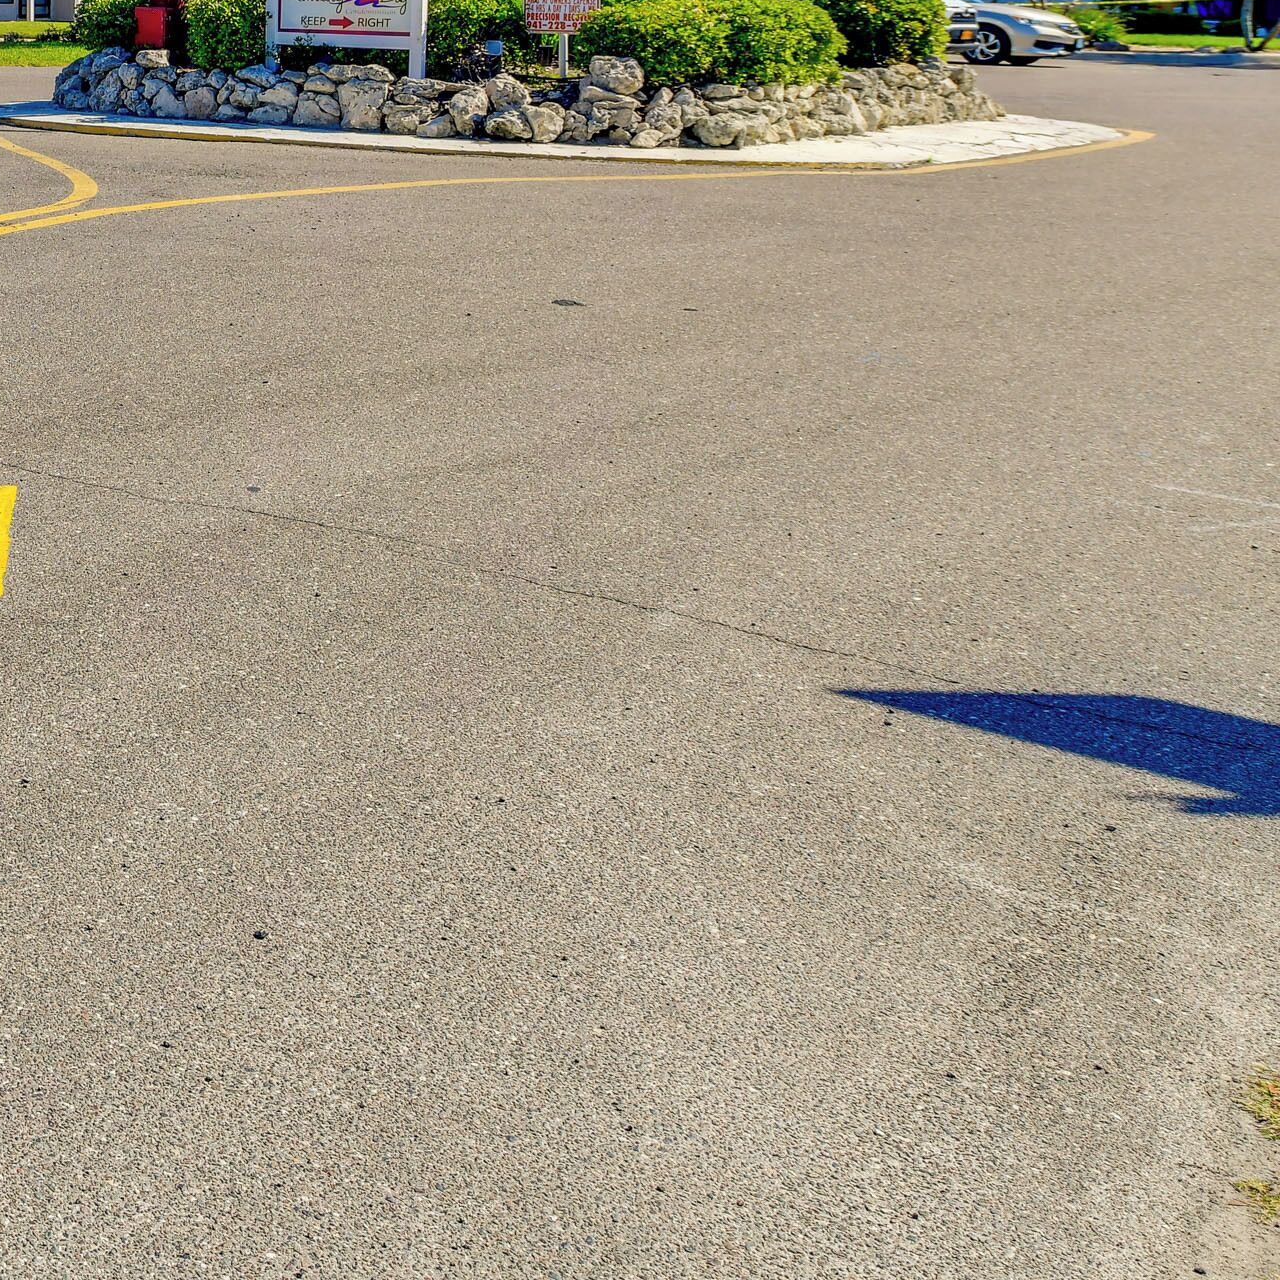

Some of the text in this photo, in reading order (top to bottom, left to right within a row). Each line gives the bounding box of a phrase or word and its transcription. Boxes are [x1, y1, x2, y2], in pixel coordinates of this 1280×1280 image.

[553, 4, 562, 12] DAY
[526, 12, 593, 21] PRECISION RECOVER
[300, 16, 397, 28] KEEP RIGHT
